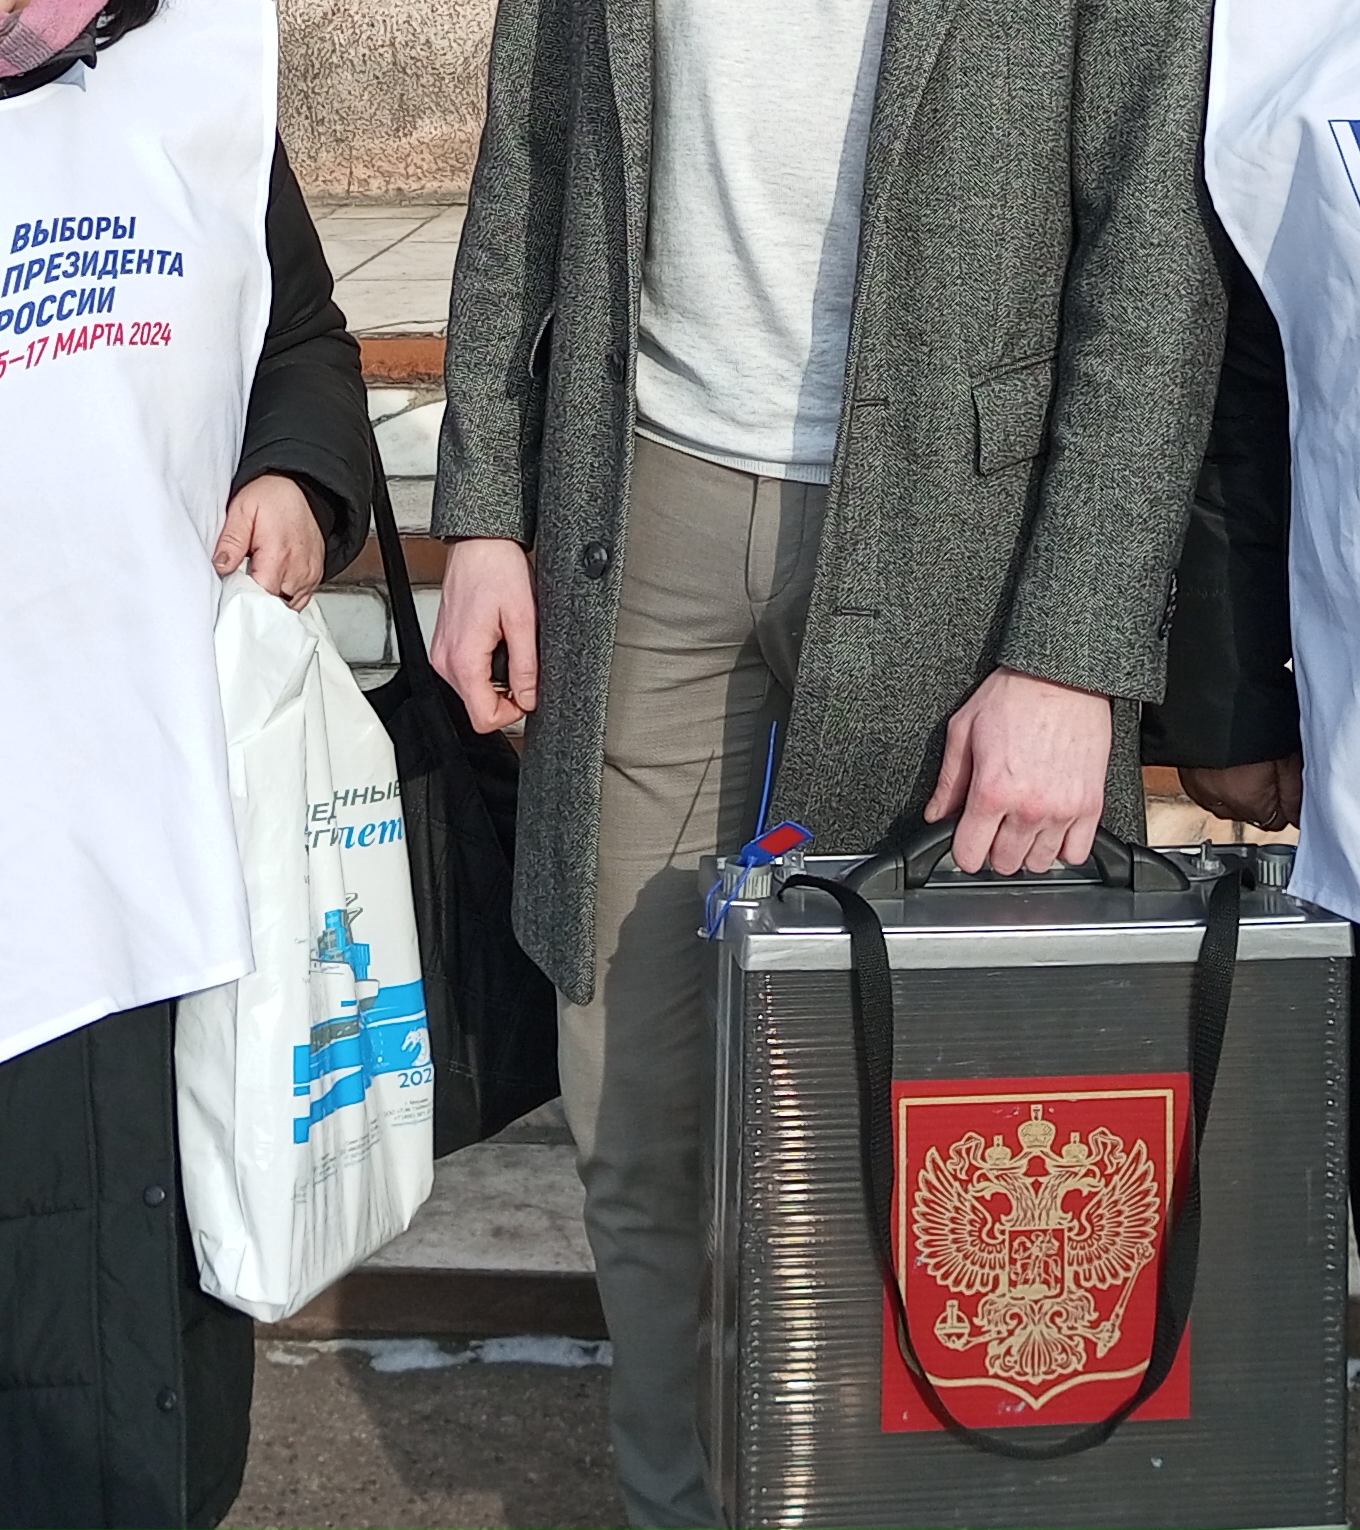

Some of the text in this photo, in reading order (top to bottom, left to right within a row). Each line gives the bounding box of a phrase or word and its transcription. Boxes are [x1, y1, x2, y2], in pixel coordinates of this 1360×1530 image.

[9, 216, 137, 255] ВЫБОРЫ
[0, 248, 184, 299] ПРЕЗИДЕНТА
[52, 322, 124, 361] МАРТА
[128, 321, 172, 346] 2024
